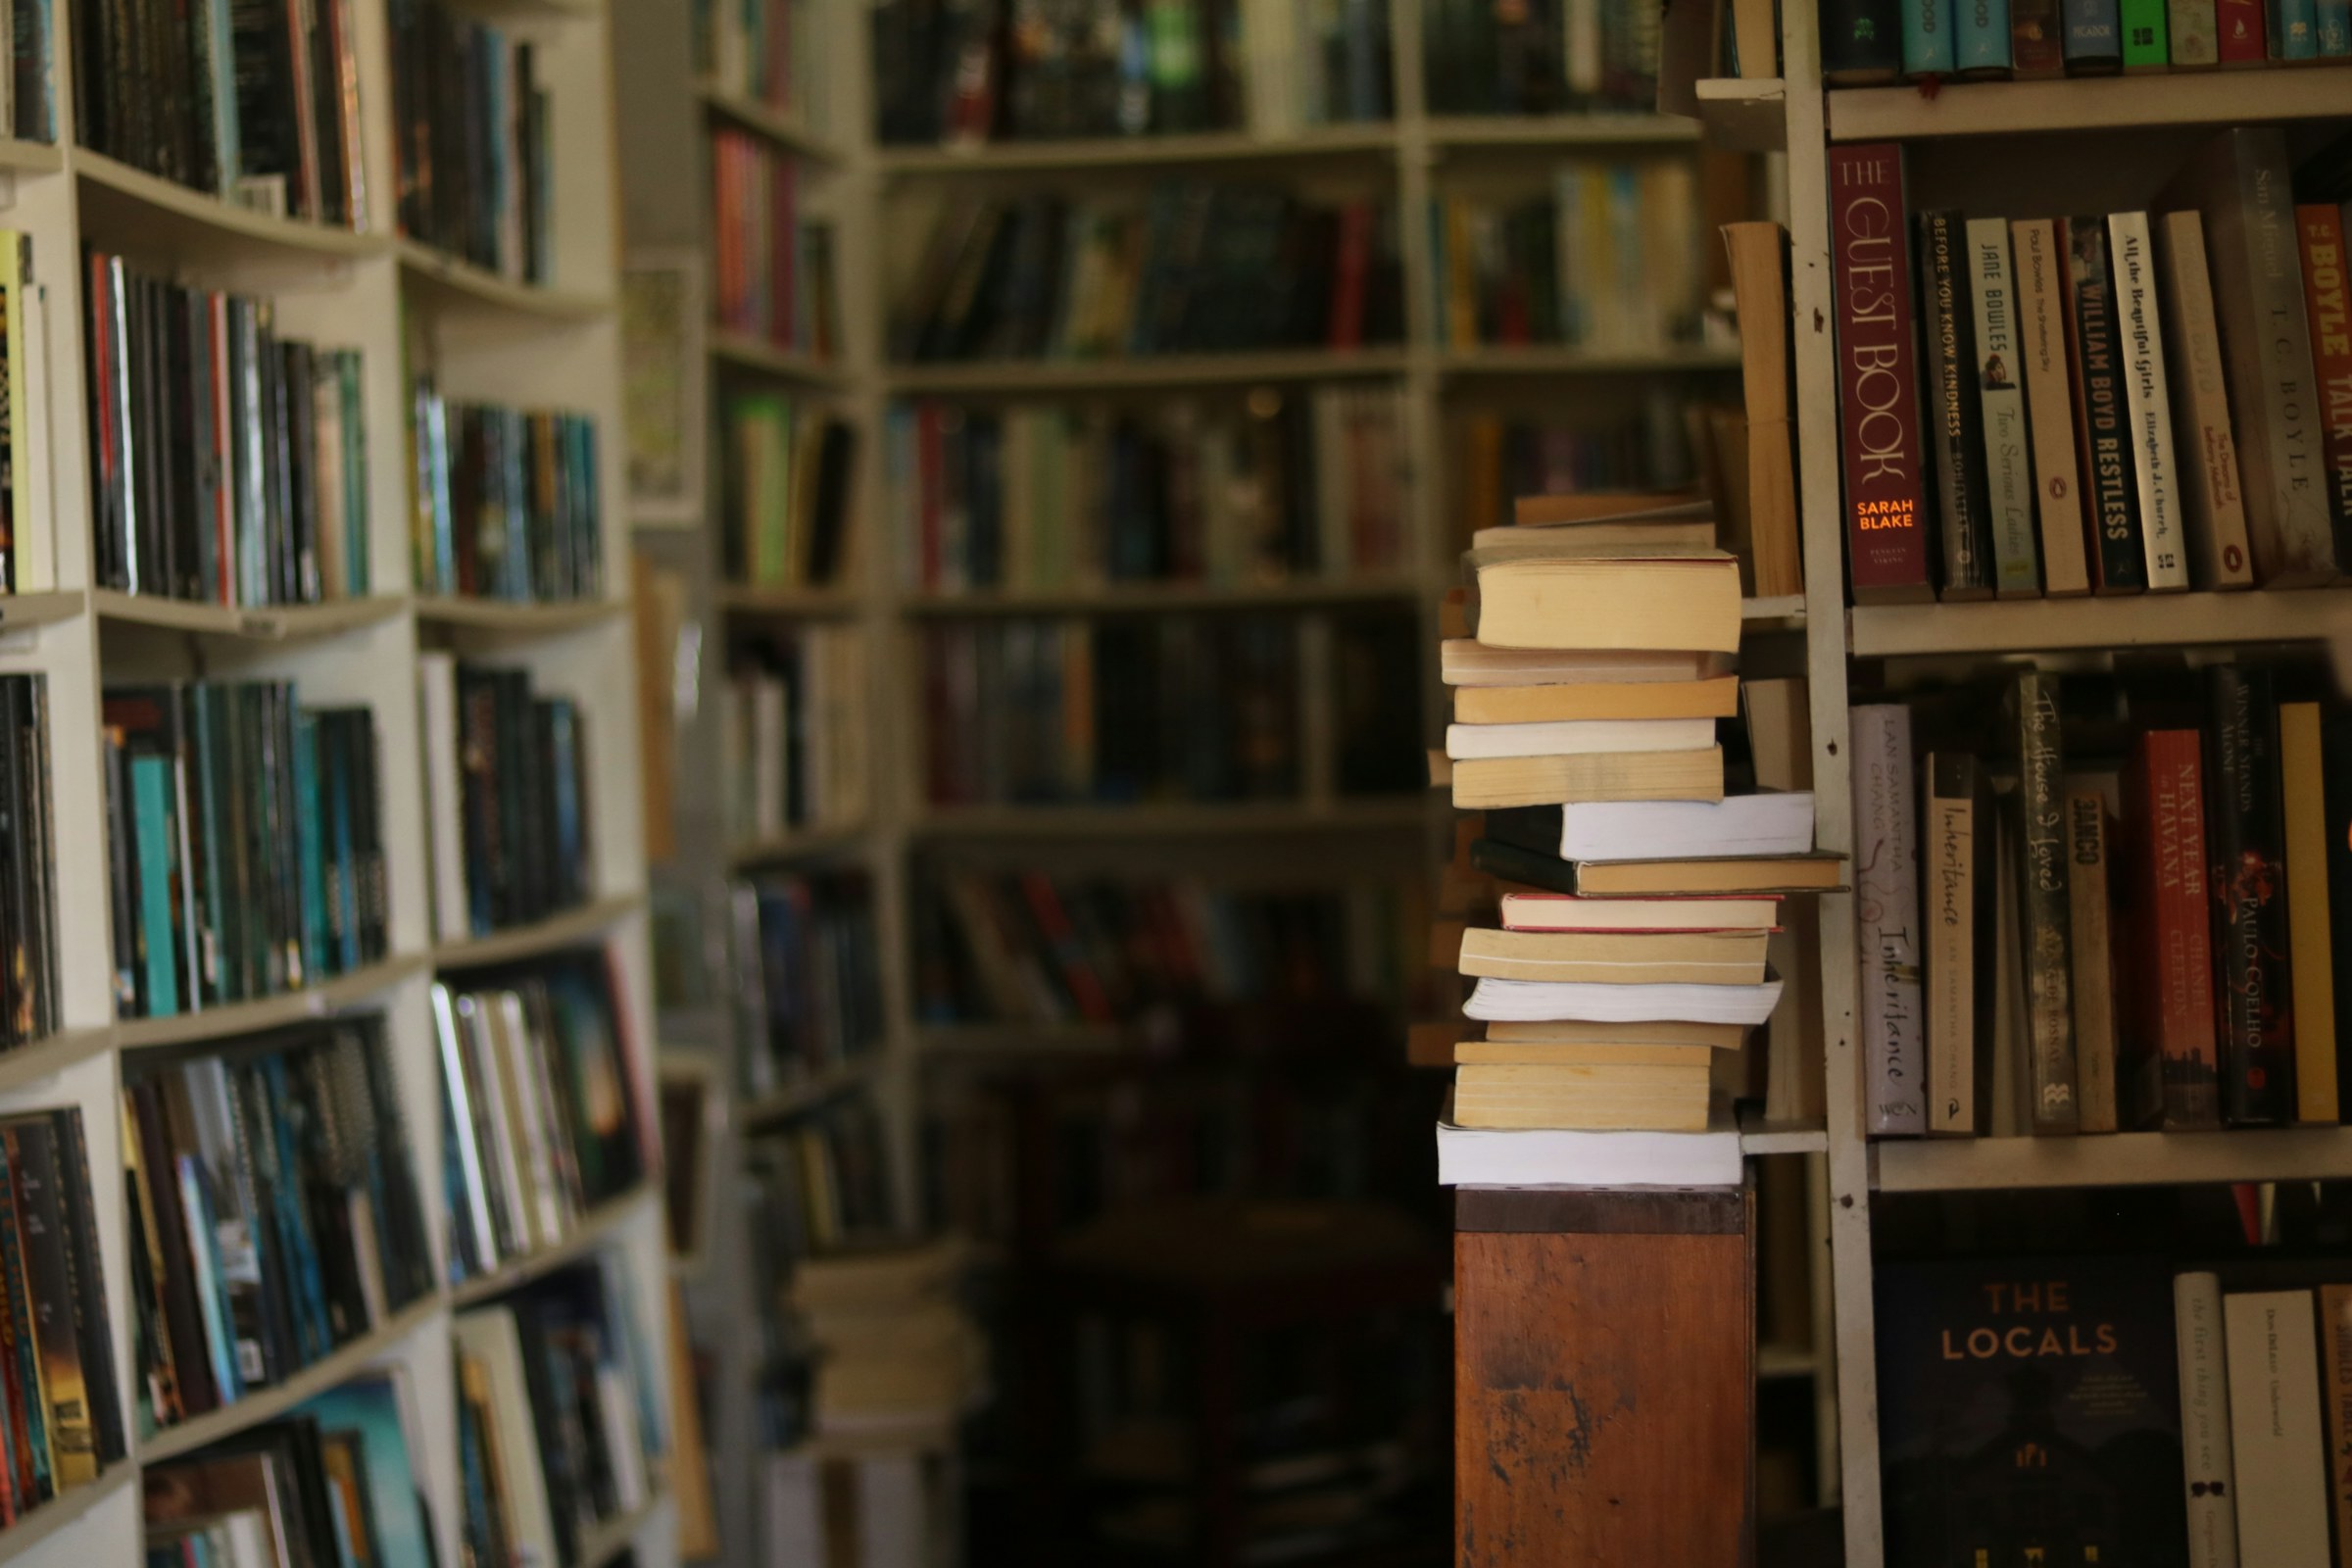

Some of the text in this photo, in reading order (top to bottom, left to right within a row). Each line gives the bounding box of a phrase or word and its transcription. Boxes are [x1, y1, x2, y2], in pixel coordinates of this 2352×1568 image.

[2073, 24, 2111, 38] PICADOR
[1838, 160, 1889, 186] THE
[1933, 218, 1950, 272] BEFORE
[2030, 229, 2043, 254] Paul
[2254, 168, 2280, 278] San Miguel
[1937, 278, 1953, 308] YOU
[1981, 243, 2008, 351] JANE BOWLES
[2032, 256, 2047, 293] Bowles
[2131, 261, 2142, 284] the
[2310, 243, 2349, 356] BOYLE
[1844, 197, 1905, 484] GUEST BOOK
[1940, 313, 1958, 358] KNOW
[2132, 288, 2153, 355] Beautiful
[1945, 364, 1962, 437] KINDNESS
[2134, 360, 2156, 399] Girls
[2272, 305, 2311, 493] T. C. BOYLE
[2327, 374, 2352, 440] TALK
[1996, 408, 2017, 438] Two
[2081, 284, 2130, 540] WILLIAM BOYD RESTLESS
[2144, 411, 2160, 469] Elizabeth
[1999, 443, 2022, 501] Serious
[1857, 499, 1914, 514] SARAH
[1859, 513, 1914, 530] BLAKE
[2005, 507, 2026, 556] Ladies
[2031, 690, 2056, 732] The
[2031, 741, 2056, 804] House
[2220, 721, 2235, 774] ALONE
[2234, 683, 2254, 812] WINNER STANDS
[1870, 762, 1886, 831] CHANG
[1887, 763, 1904, 873] SAMANTHA
[2158, 792, 2180, 889] HAVANA
[2177, 762, 2202, 896] NEXT YEAR
[1941, 807, 1969, 926] Inheritance
[2032, 837, 2062, 892] Loved
[2168, 929, 2189, 1016] CLEETON
[2187, 933, 2207, 1008] CHANEL
[2240, 896, 2263, 1049] PAULO COELHO
[1879, 926, 1912, 1080] Inheritance
[1983, 1281, 2070, 1314] THE
[2192, 1298, 2208, 1321] the
[1941, 1322, 2118, 1360] LOCALS
[2194, 1326, 2208, 1360] first
[2194, 1367, 2212, 1407] thing
[2194, 1411, 2213, 1440] you
[2200, 1445, 2214, 1470] see
